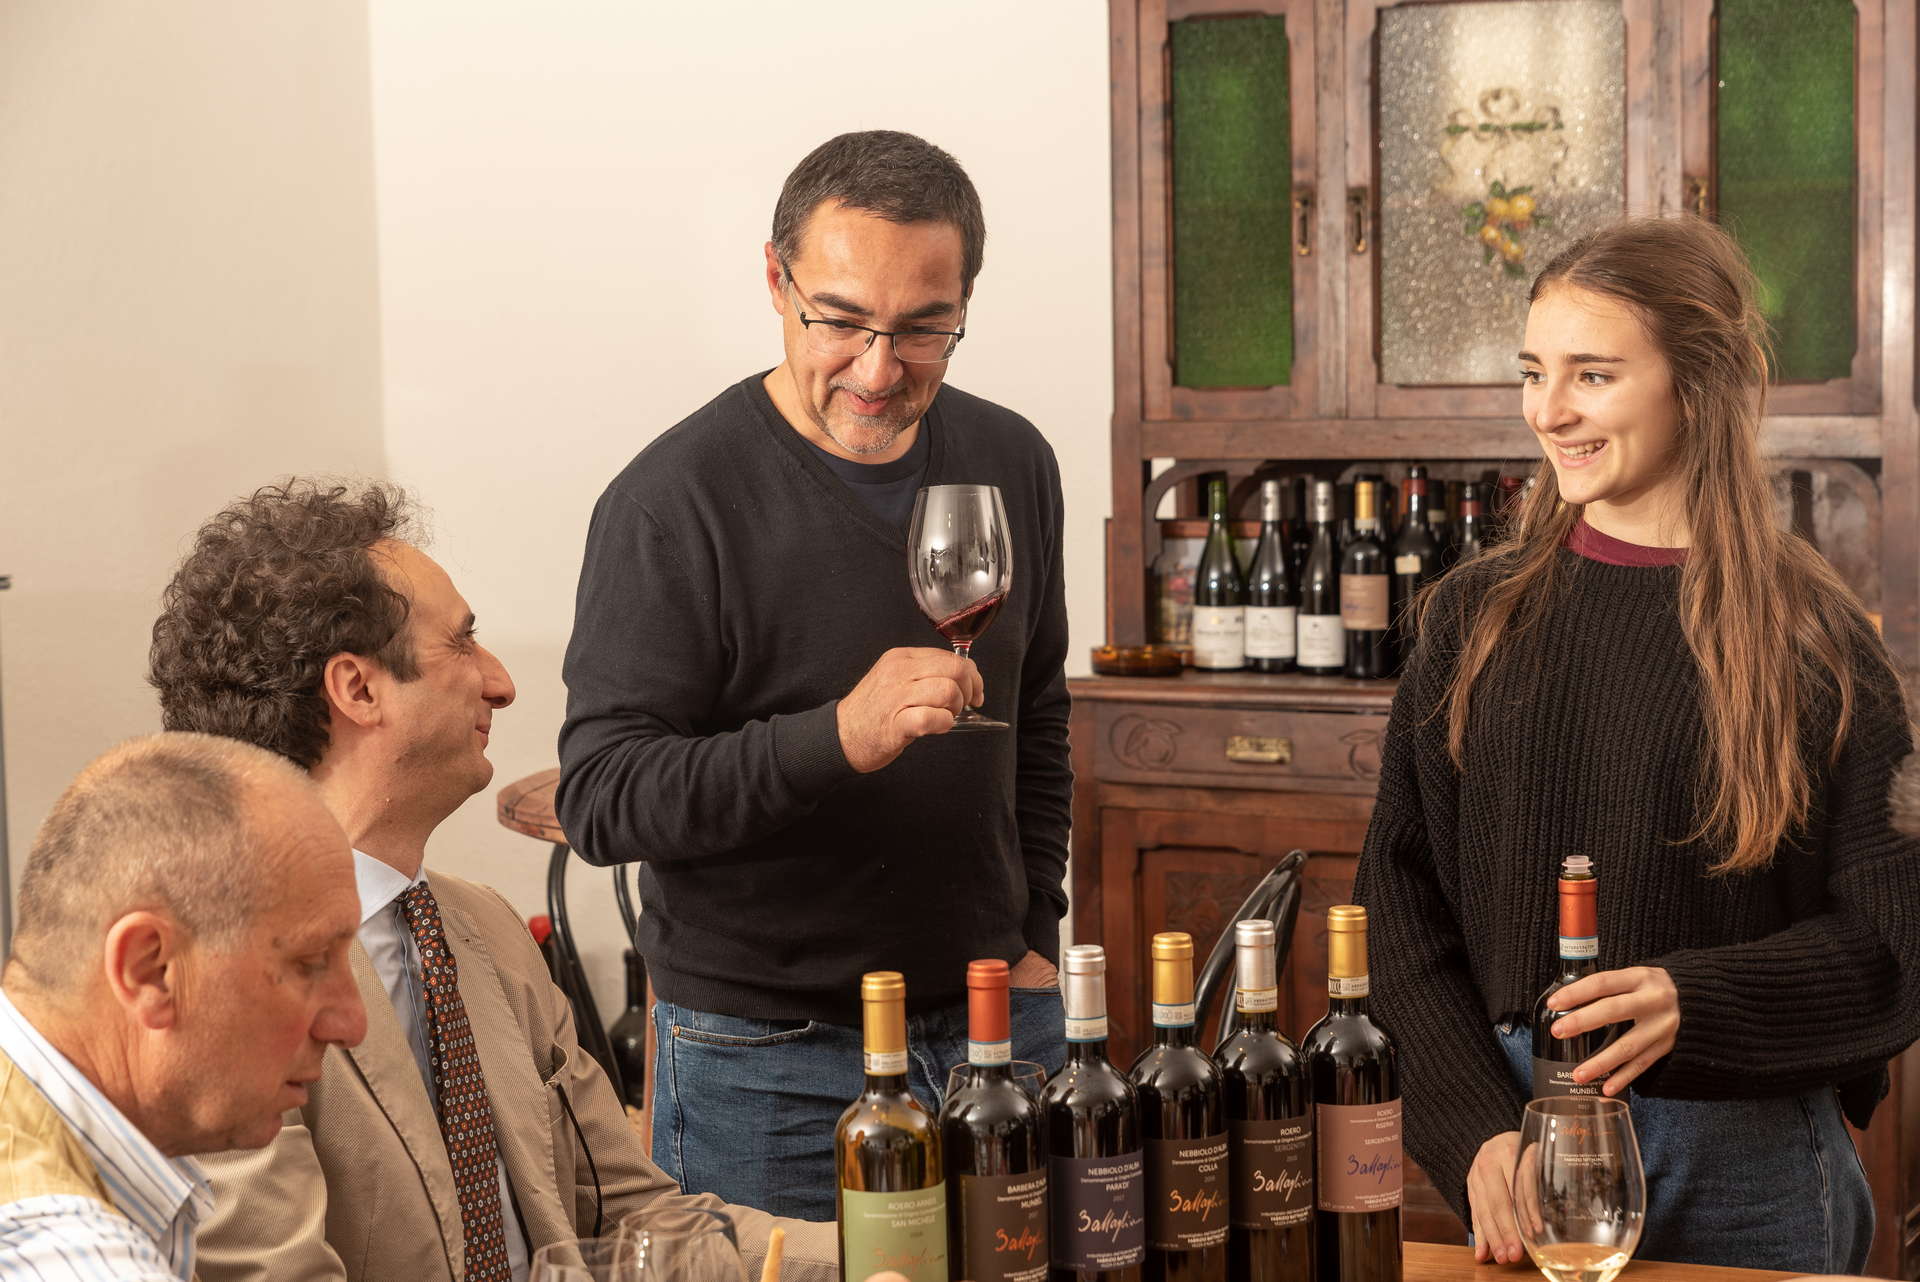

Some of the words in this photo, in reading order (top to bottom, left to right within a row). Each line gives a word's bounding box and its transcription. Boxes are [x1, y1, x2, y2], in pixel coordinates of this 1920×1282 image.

[1557, 1071, 1574, 1079] BARB
[1569, 1087, 1599, 1095] MUNBEL
[1280, 1126, 1301, 1136] ROERO
[1179, 1147, 1213, 1158] NEBBIOLO
[1087, 1165, 1124, 1176] NEBBIOLO
[1198, 1163, 1219, 1173] COLLA
